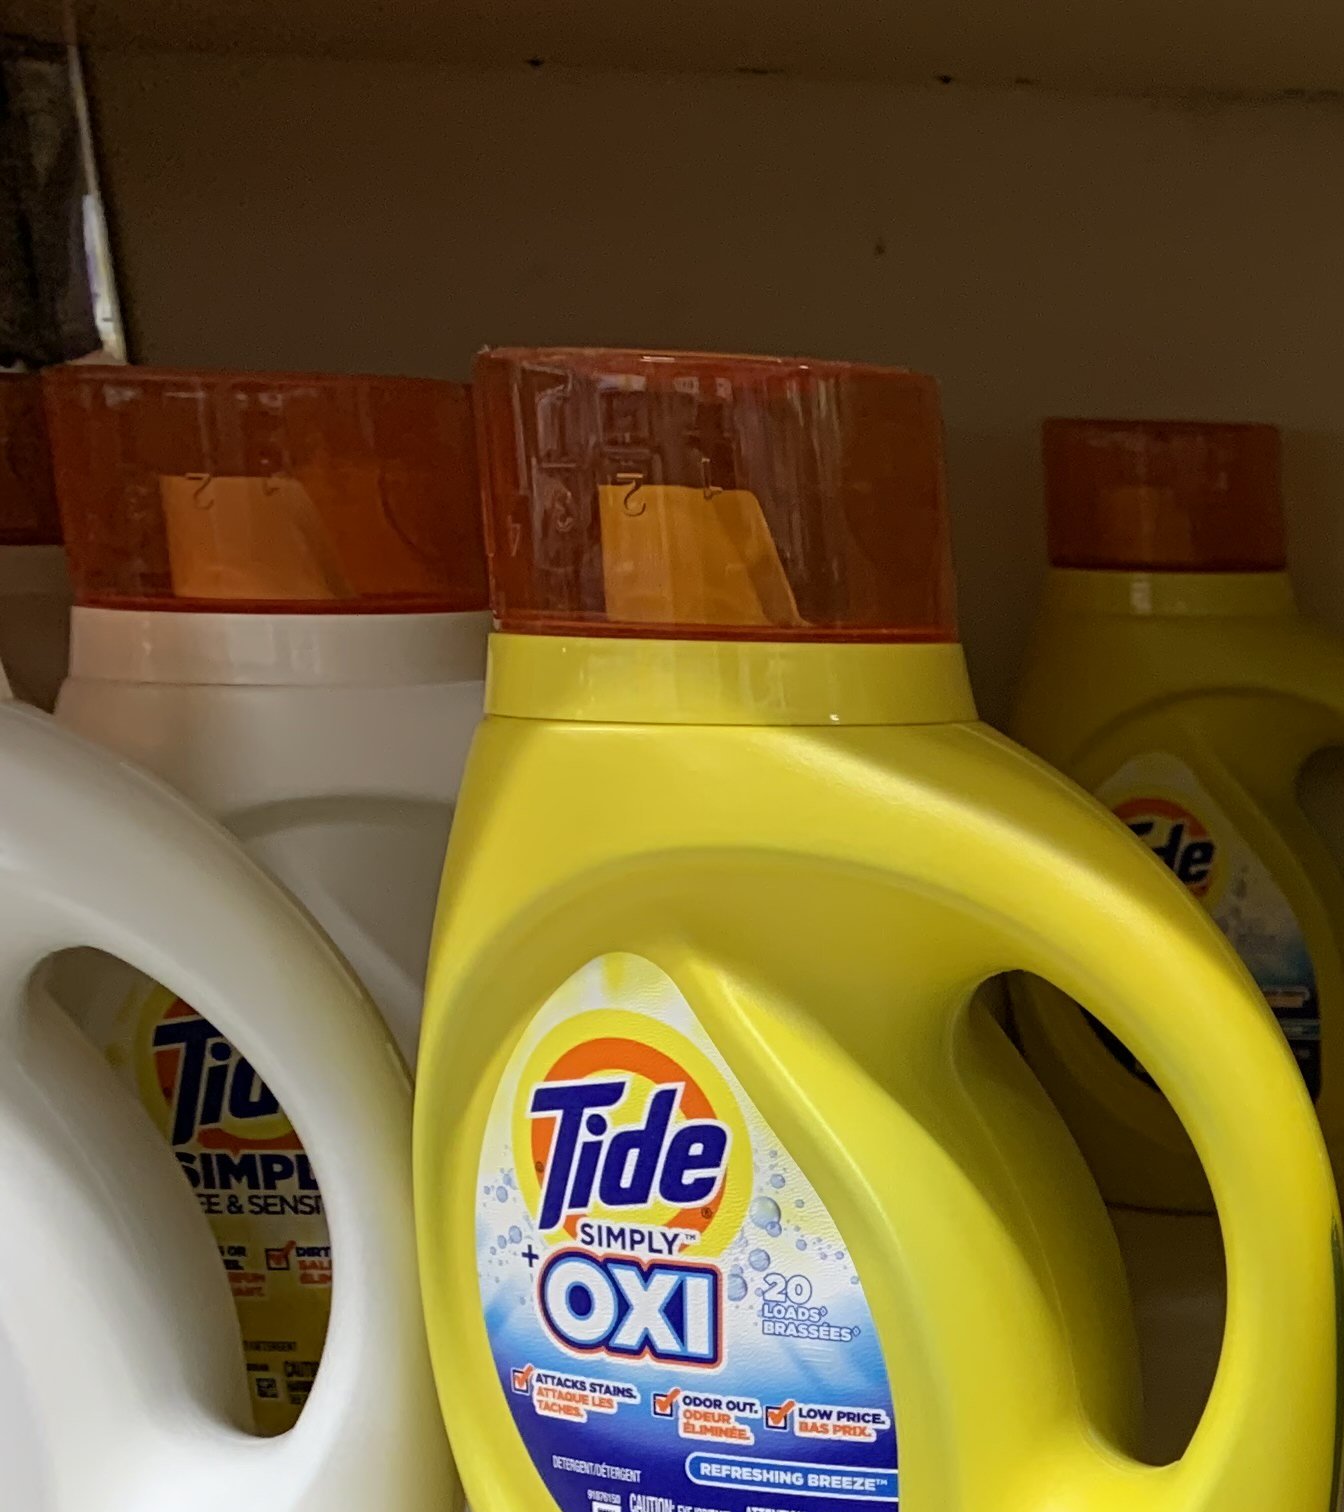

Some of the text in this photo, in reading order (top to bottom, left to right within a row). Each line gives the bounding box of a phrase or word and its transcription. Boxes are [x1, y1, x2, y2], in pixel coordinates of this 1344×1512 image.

[176, 1152, 320, 1190] SIMPL
[530, 1081, 728, 1230] Tide
[763, 1273, 813, 1305] 20
[541, 1252, 720, 1363] OXI
[682, 1395, 758, 1415] ODOR OUT.
[799, 1408, 886, 1425] LOW PRICE.
